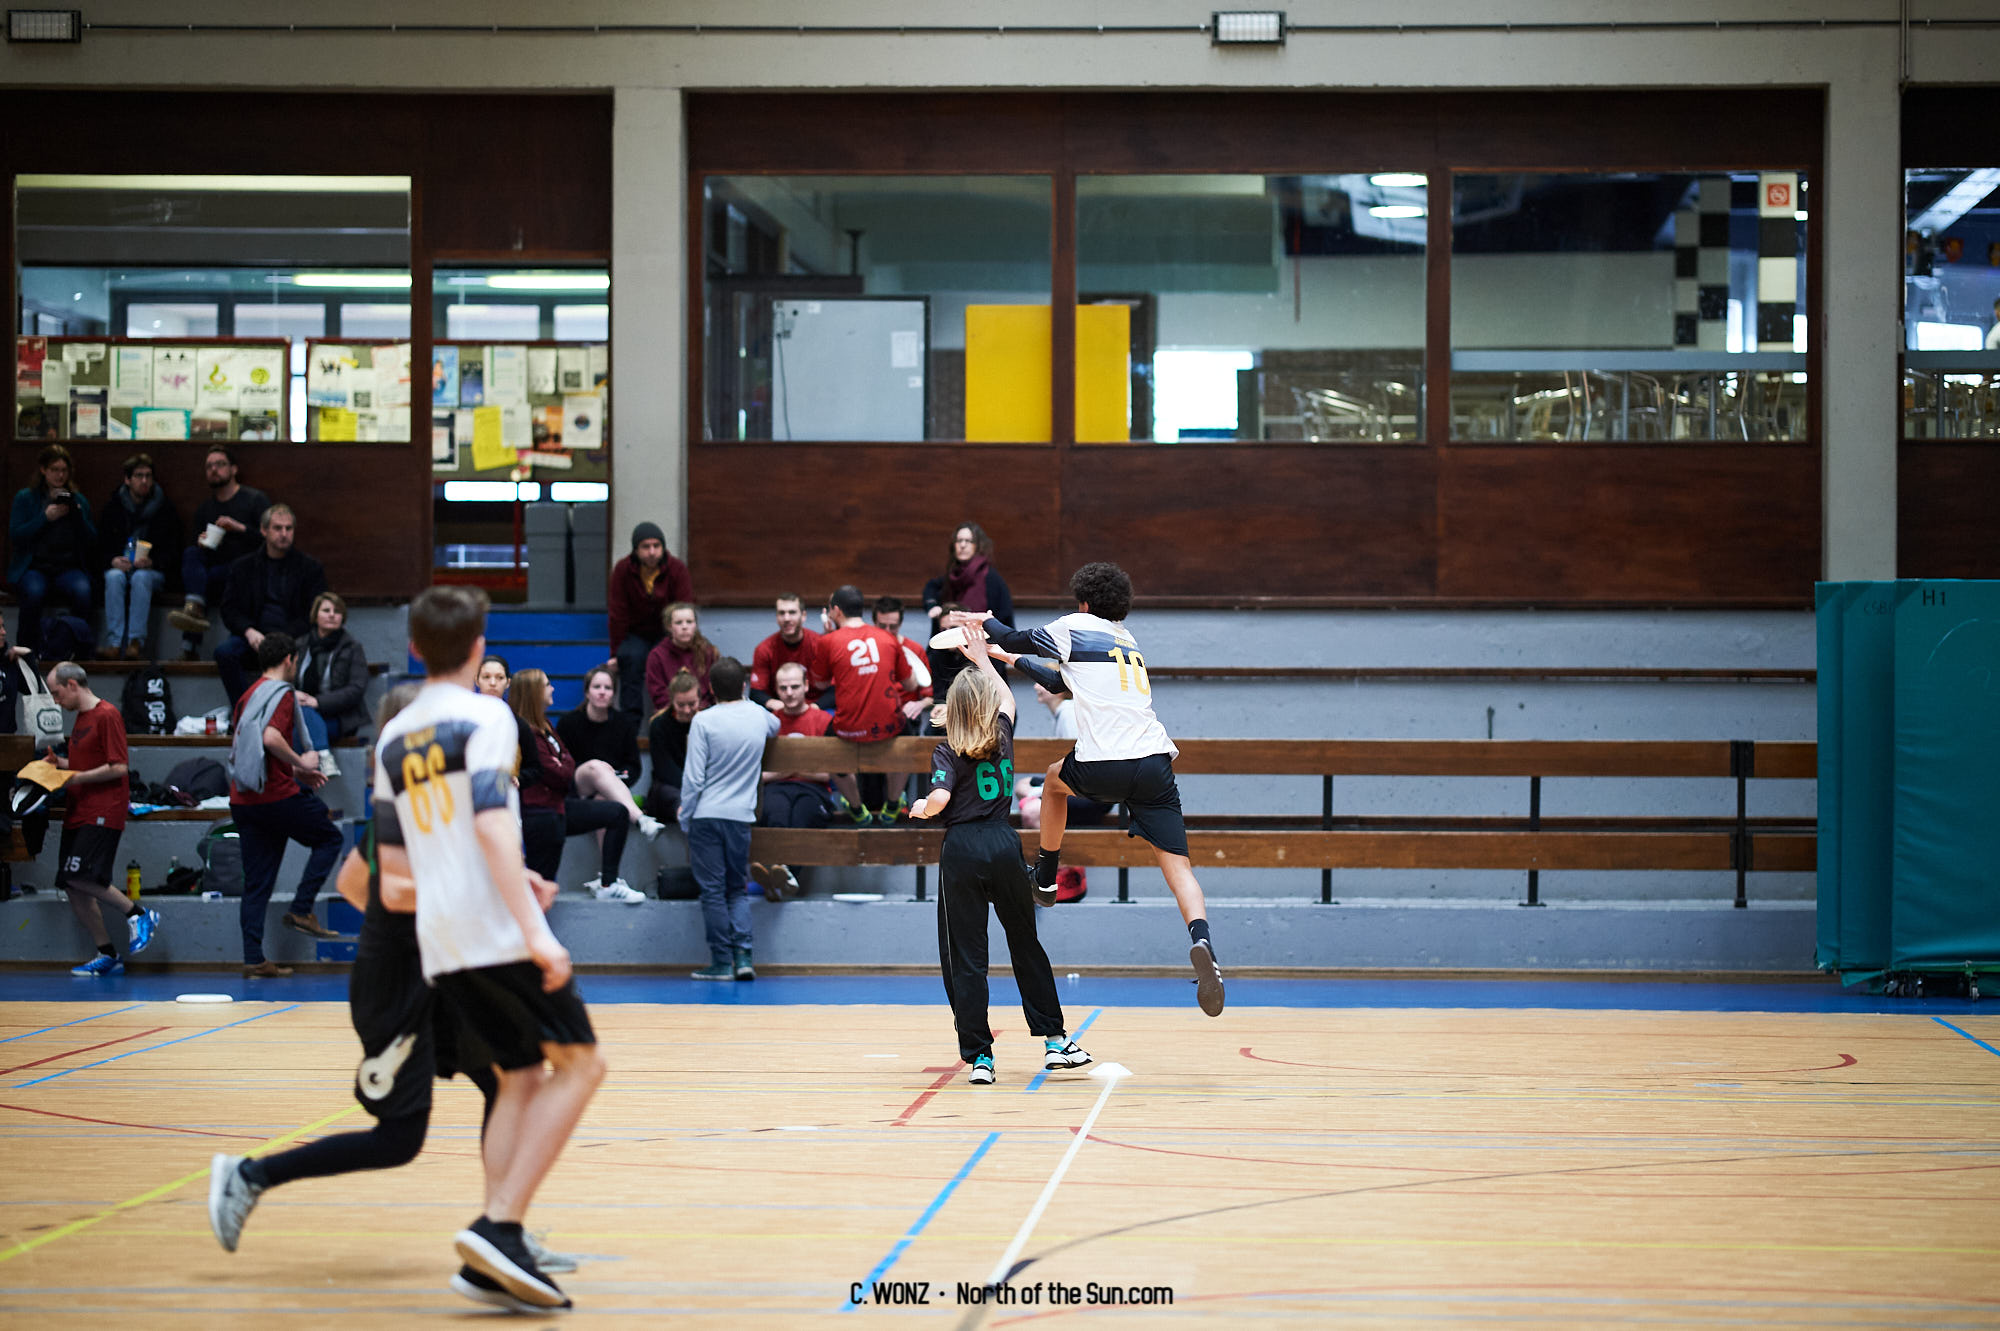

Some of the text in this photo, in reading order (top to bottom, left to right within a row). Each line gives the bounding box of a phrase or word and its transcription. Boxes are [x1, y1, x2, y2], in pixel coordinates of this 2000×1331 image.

[847, 637, 880, 666] 21
[1108, 646, 1151, 696] 10
[401, 744, 455, 834] 66
[976, 759, 1014, 800] 66
